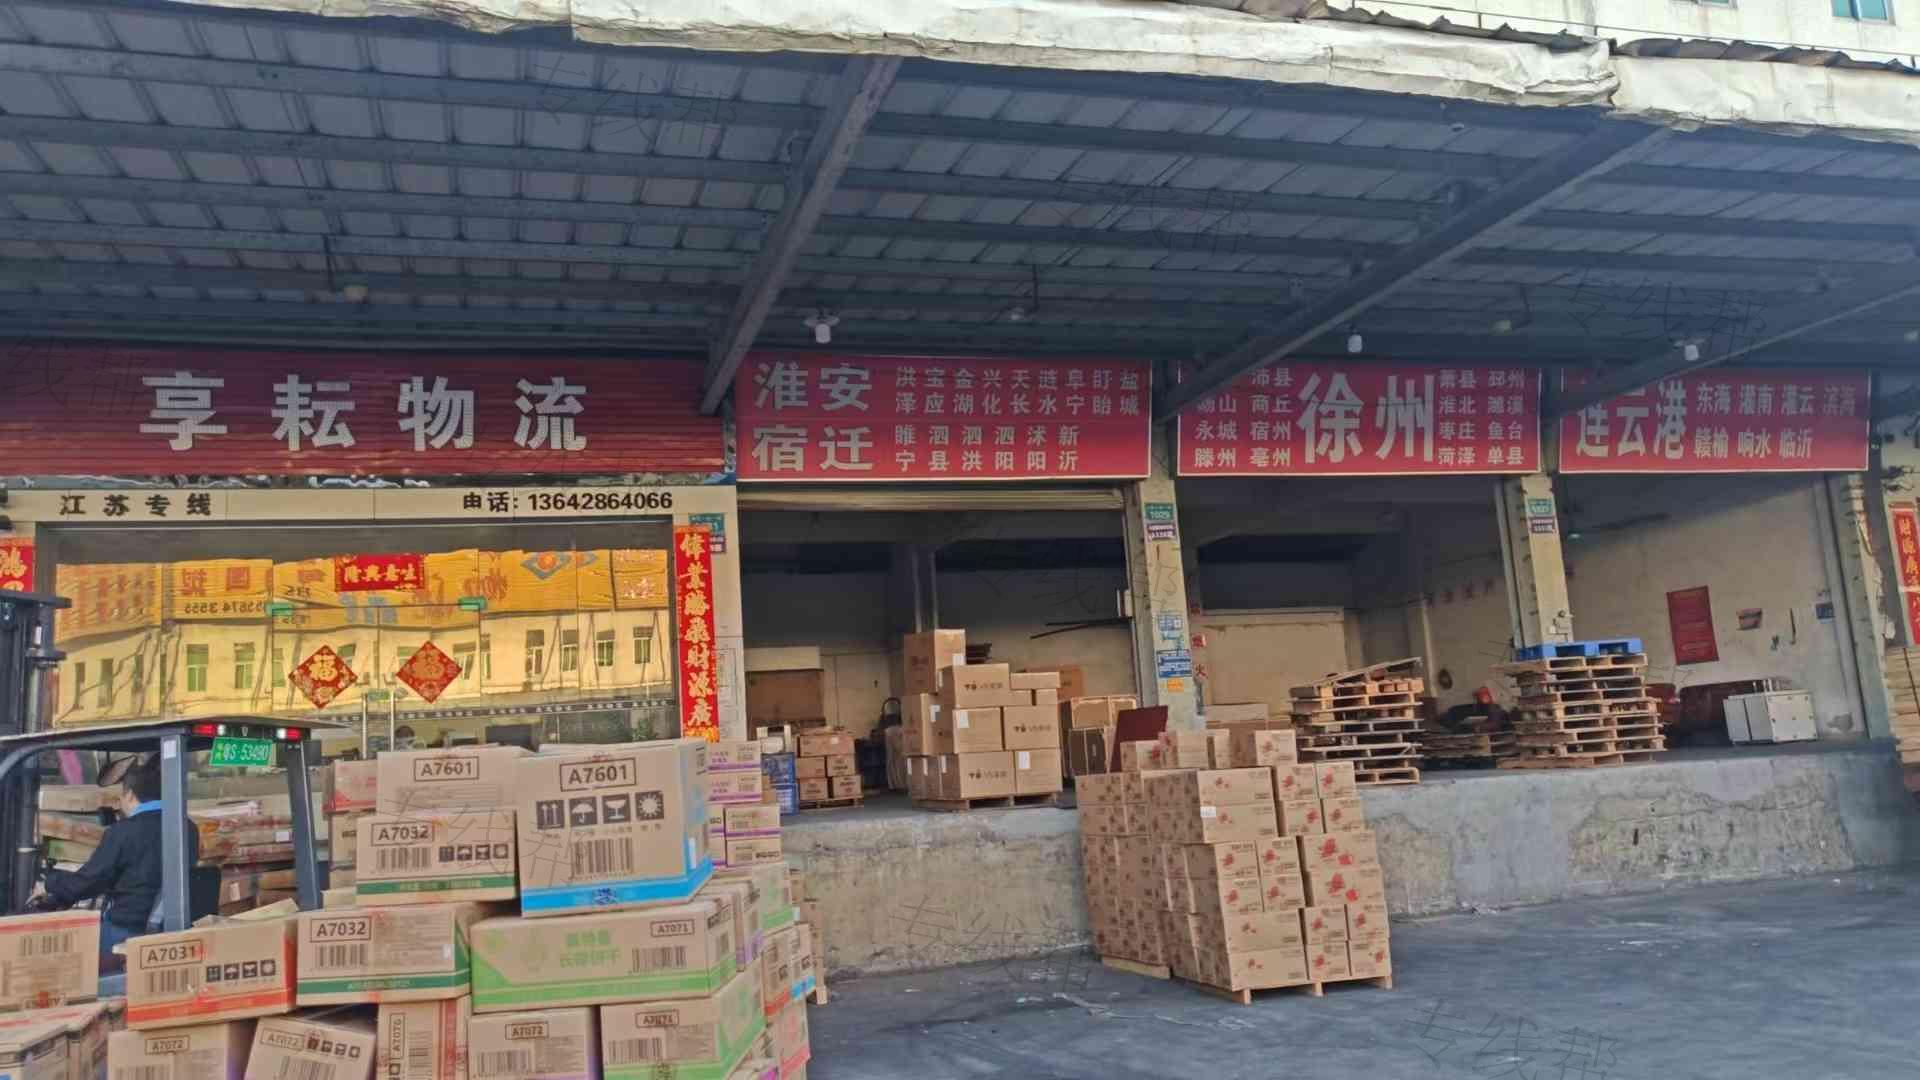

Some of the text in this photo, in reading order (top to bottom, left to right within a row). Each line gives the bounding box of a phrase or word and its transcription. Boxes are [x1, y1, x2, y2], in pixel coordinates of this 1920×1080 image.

[753, 361, 873, 411] 淮安
[1249, 394, 1294, 414] 商丘
[1440, 395, 1476, 414] 淮北
[1697, 381, 1731, 415] 东海
[1739, 384, 1774, 416] 灌南
[1781, 384, 1815, 416] 灌云
[140, 370, 587, 450] 享耘物流
[1298, 372, 1435, 464] 徐州
[1576, 379, 1687, 459] 连云港
[1195, 420, 1291, 440] 永城 宿州
[1440, 421, 1523, 440] 枣庄 鱼台
[752, 424, 874, 471] 宿迁
[1738, 427, 1772, 458] 响水
[1779, 427, 1814, 459] 临沂
[1488, 446, 1525, 465] 单县
[59, 493, 211, 516] 江苏专线
[421, 762, 473, 777] A7601
[568, 764, 628, 785] A7601
[378, 825, 430, 841] A7032
[316, 921, 367, 937] A7032
[146, 945, 195, 963] A7031
